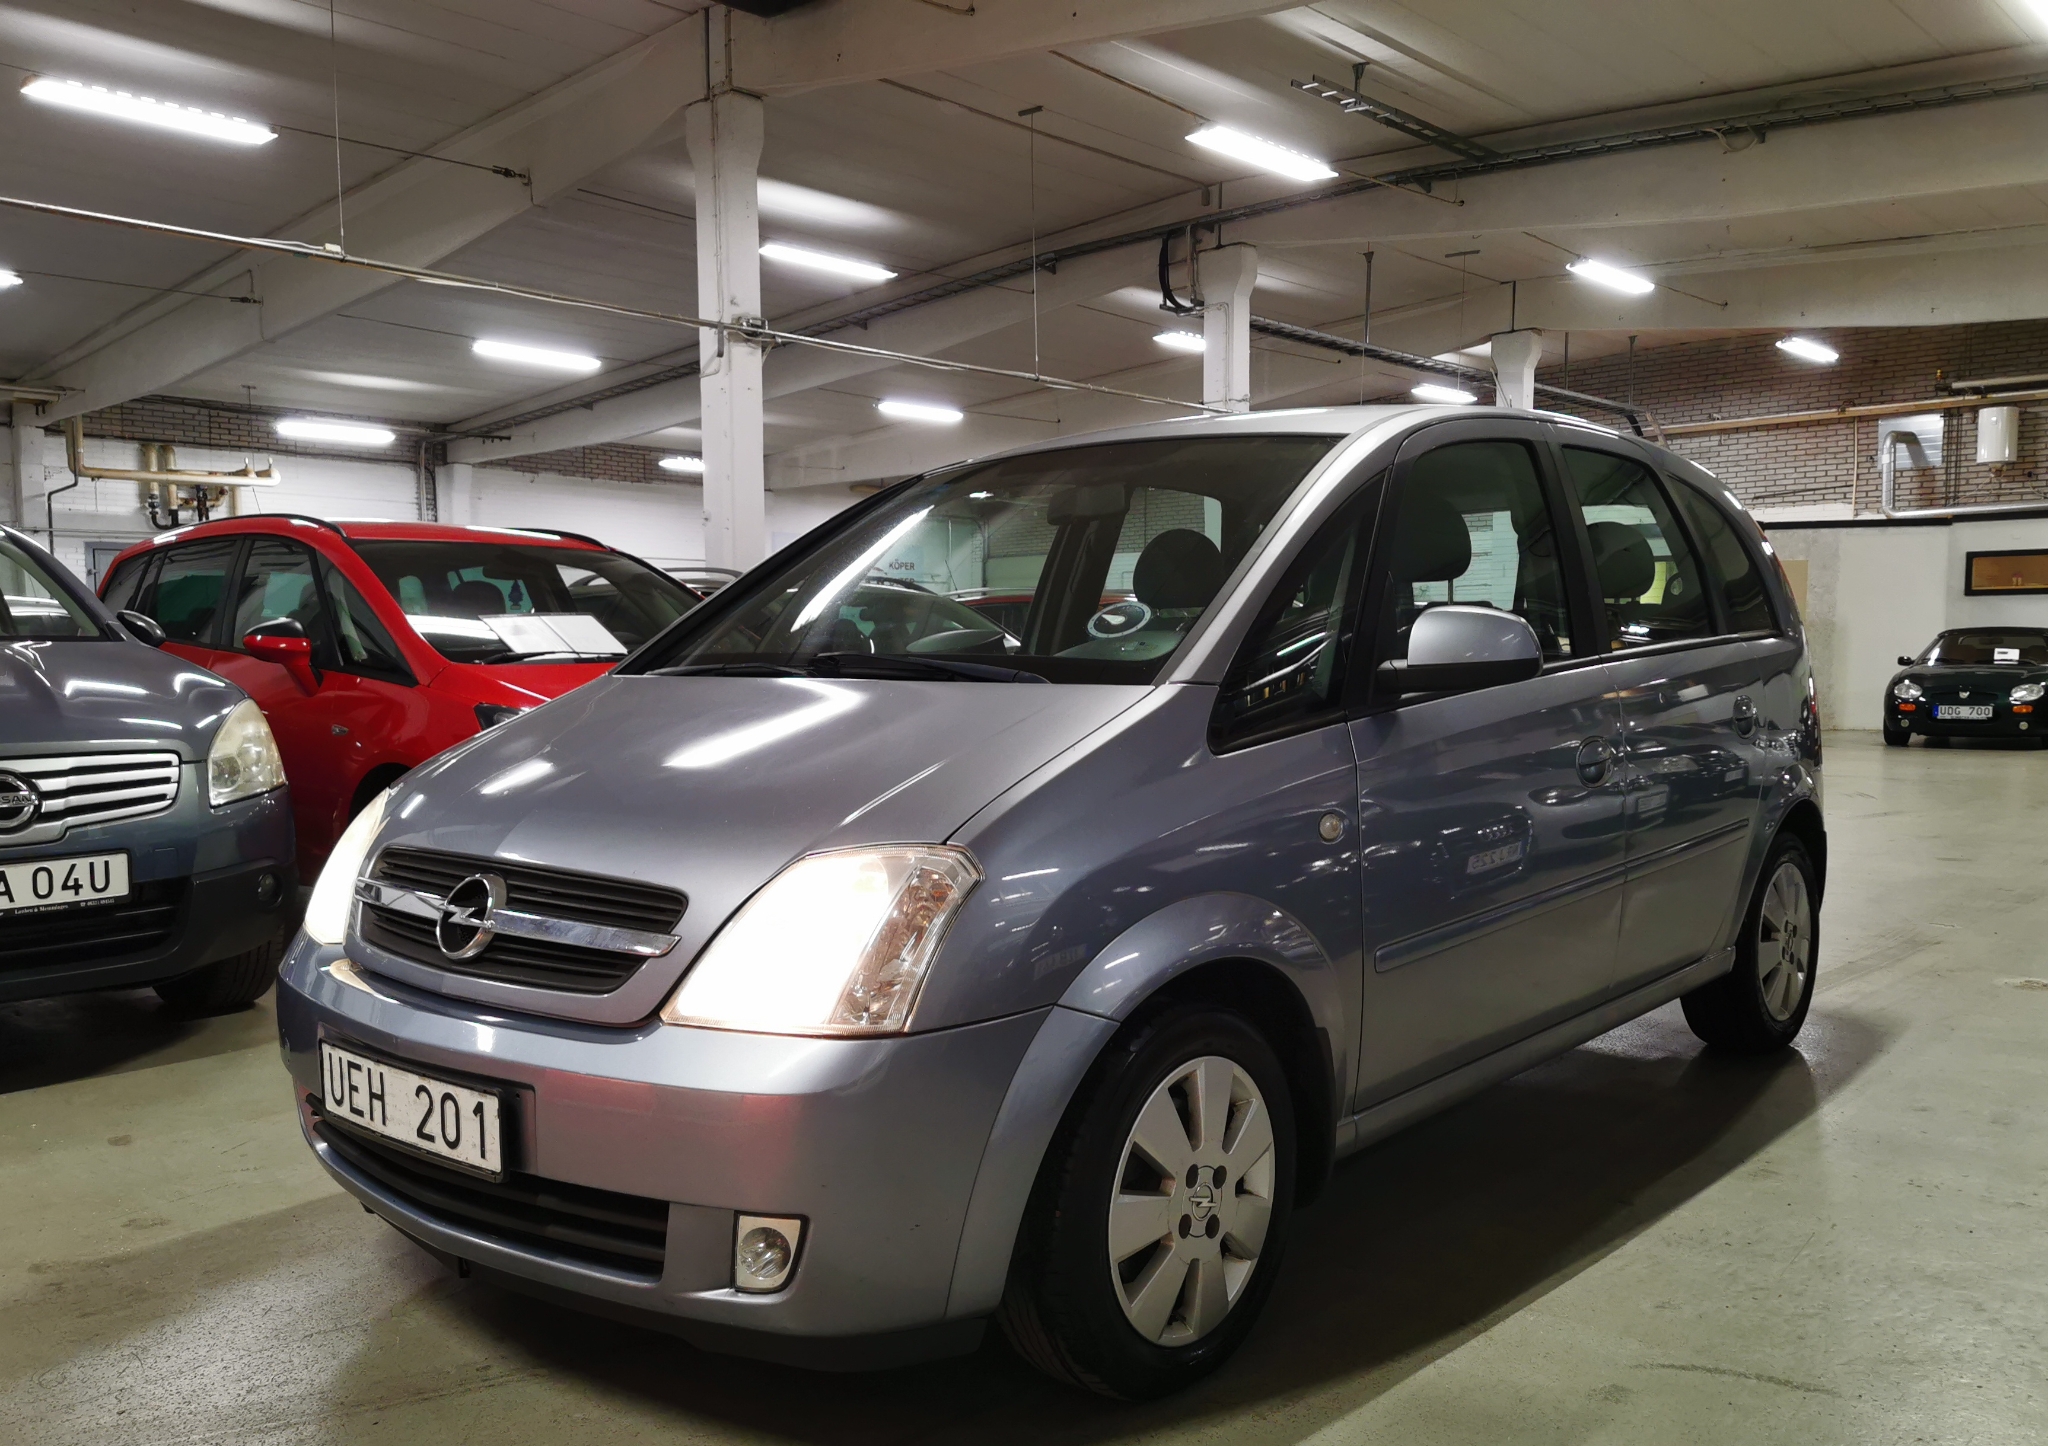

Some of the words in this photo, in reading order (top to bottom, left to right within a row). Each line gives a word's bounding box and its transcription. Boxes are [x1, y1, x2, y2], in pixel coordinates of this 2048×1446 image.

[889, 559, 915, 571] KÖPER
[1940, 706, 1961, 716] UDG
[1969, 707, 1990, 716] 700
[32, 860, 110, 899] 04U
[328, 1052, 387, 1127] UEH
[415, 1084, 487, 1160] 201
